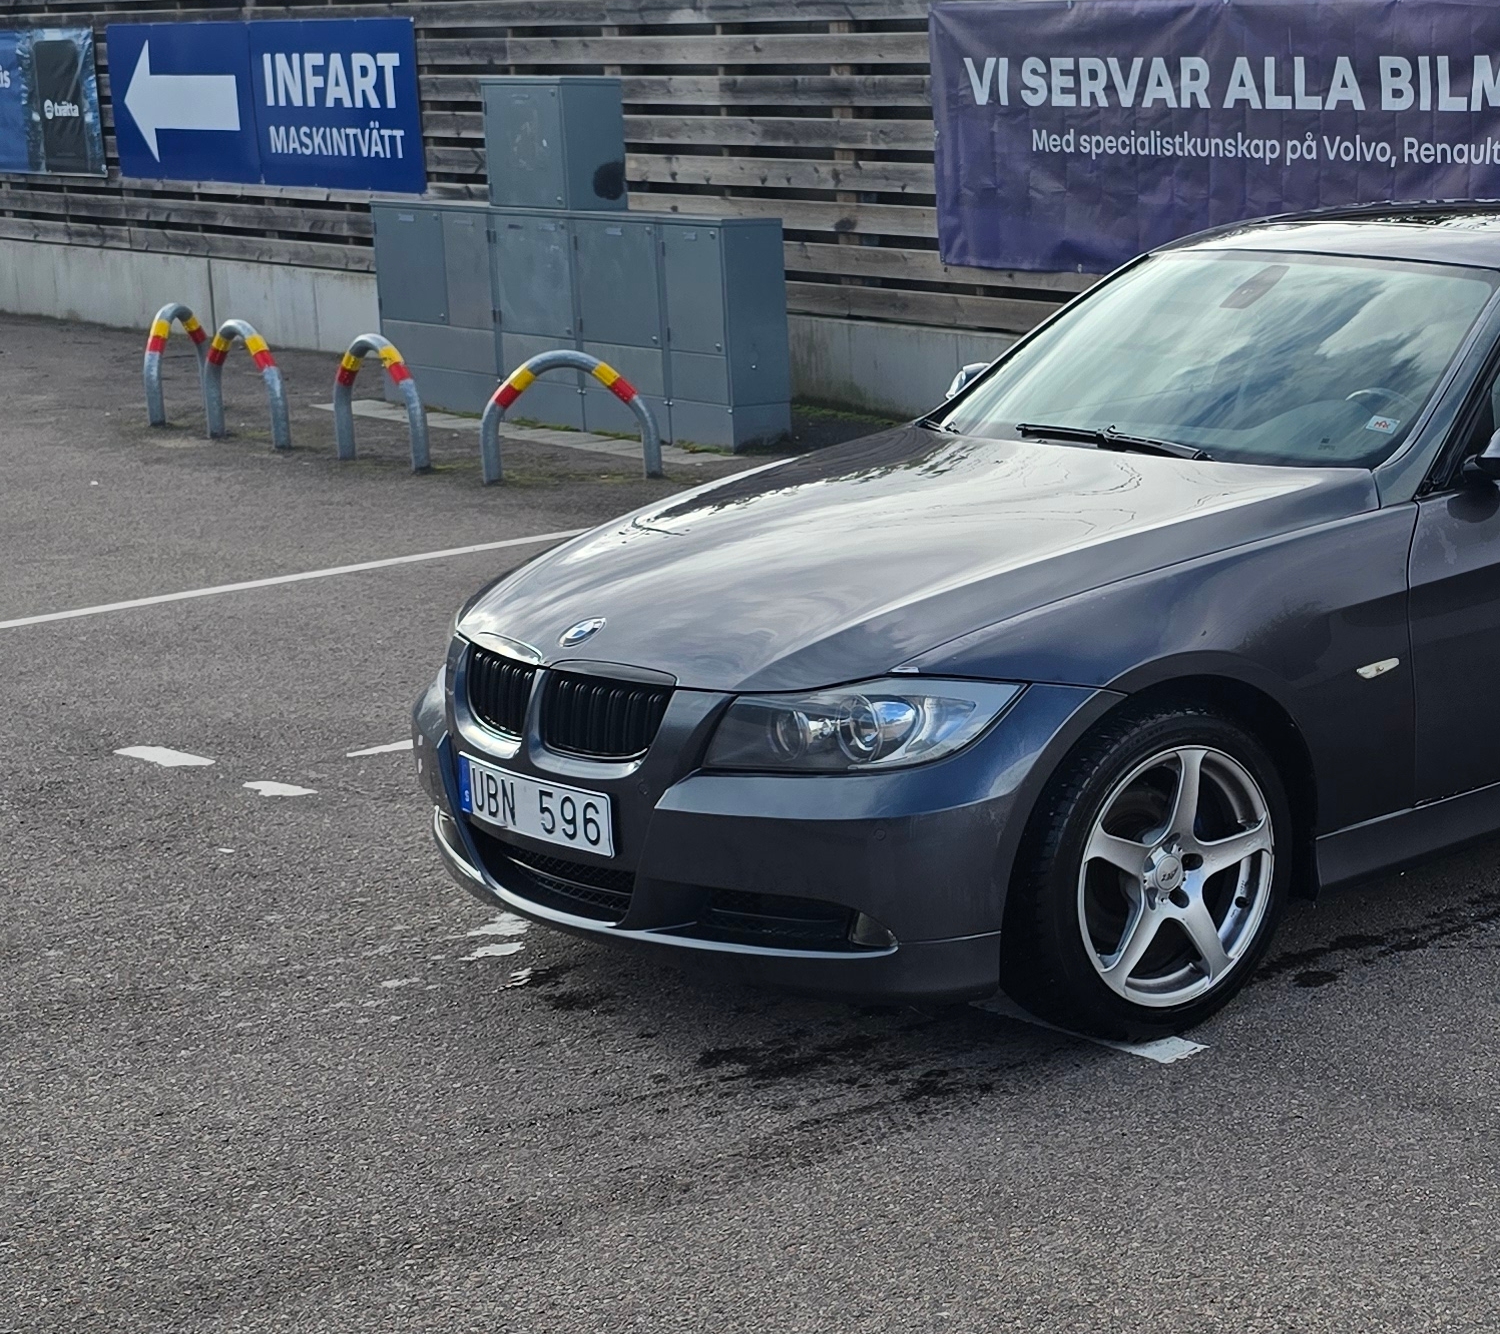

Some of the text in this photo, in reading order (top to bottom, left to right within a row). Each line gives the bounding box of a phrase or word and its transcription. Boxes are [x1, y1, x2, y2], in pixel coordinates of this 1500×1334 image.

[263, 52, 400, 109] INFART
[963, 57, 1009, 106] VI
[1021, 56, 1211, 108] SERVAR
[1223, 56, 1366, 111] ALLA
[269, 121, 405, 159] MASKINTVÄTT
[1032, 129, 1075, 153] Med
[1079, 130, 1281, 165] specialistkunskap
[1285, 132, 1317, 166] på
[1322, 135, 1397, 168] Volvo,
[471, 766, 601, 845] UBN 596
